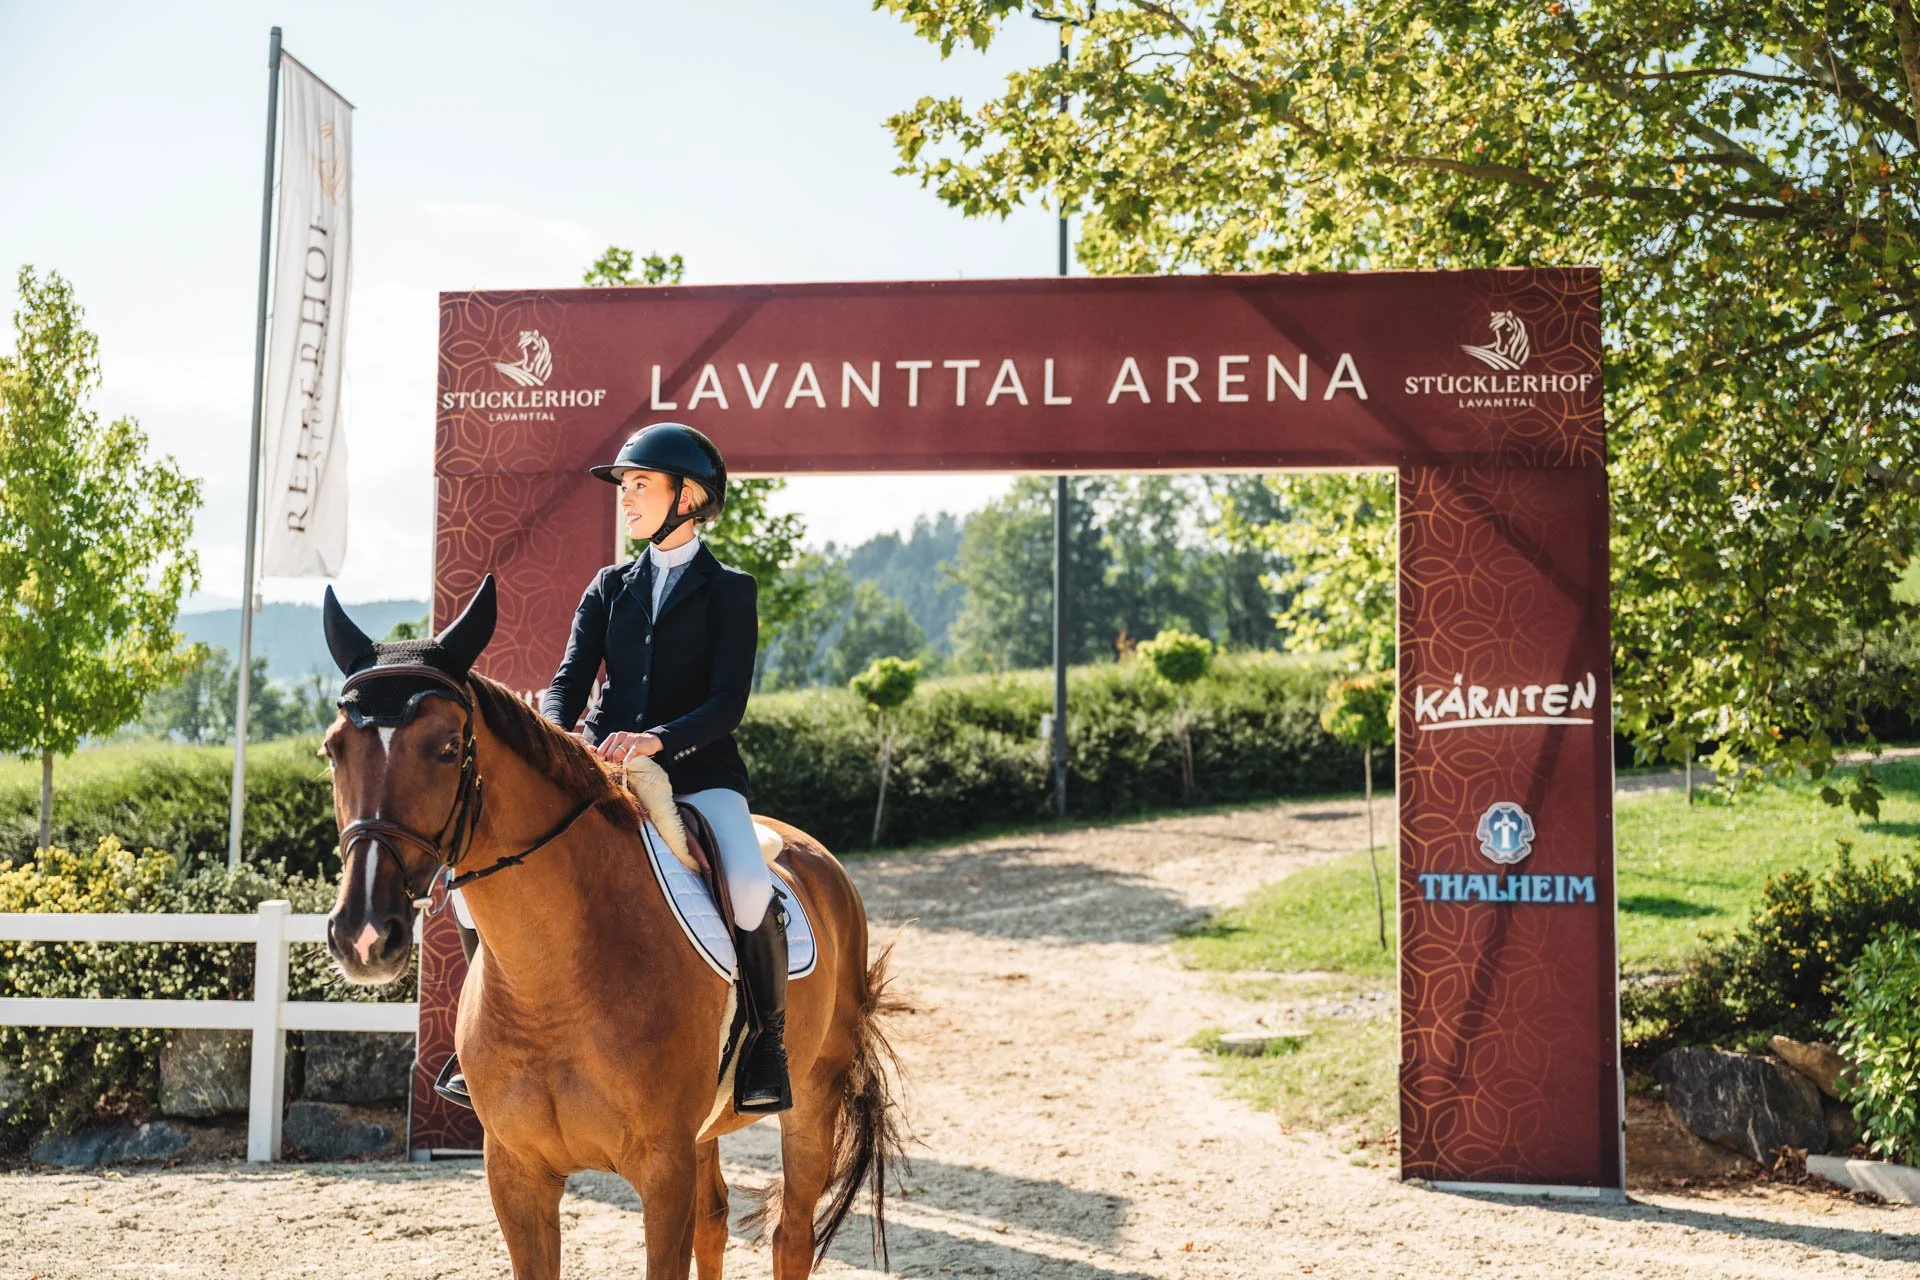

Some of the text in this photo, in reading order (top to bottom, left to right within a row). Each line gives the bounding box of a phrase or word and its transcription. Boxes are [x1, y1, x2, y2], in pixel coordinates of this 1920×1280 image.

[651, 352, 1369, 411] LAVANTTAL ARENA
[1404, 373, 1594, 395] STÜCKLERHOF
[442, 389, 607, 410] STÜCKLERHOF
[1458, 397, 1536, 409] LAVANTTAL
[488, 411, 556, 422] LAVANTTAL
[1418, 872, 1597, 904] THALHEIM
